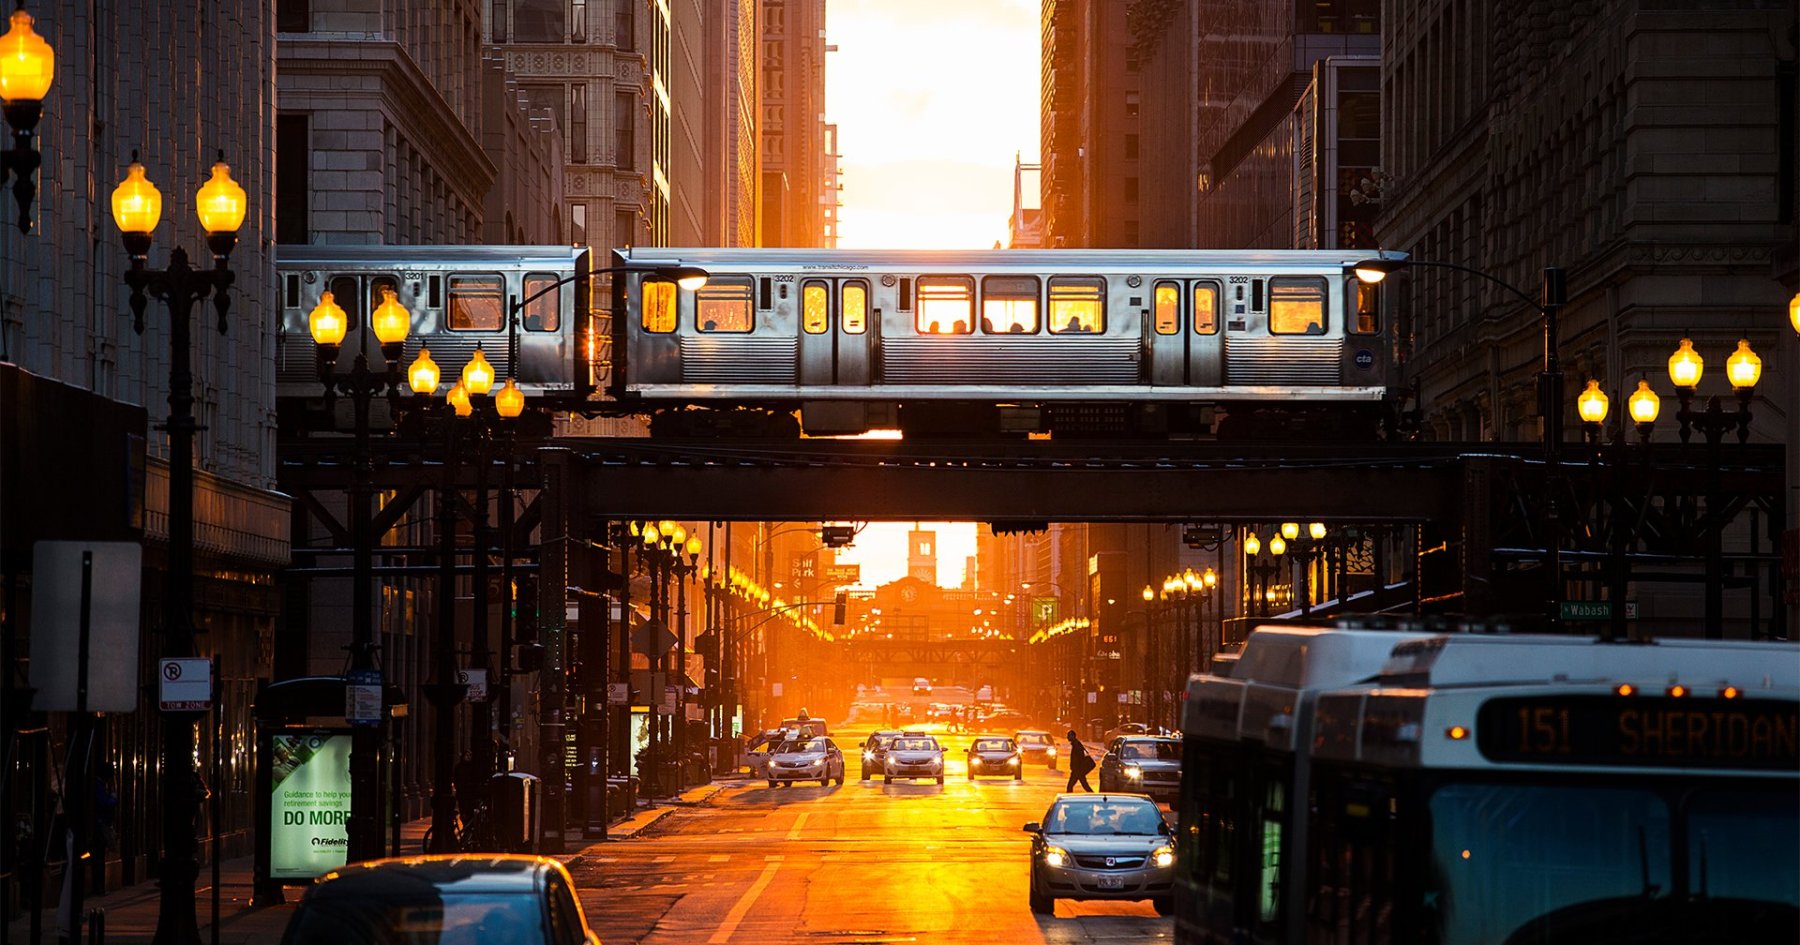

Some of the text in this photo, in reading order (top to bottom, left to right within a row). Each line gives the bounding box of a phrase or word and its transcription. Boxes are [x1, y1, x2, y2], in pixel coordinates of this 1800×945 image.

[405, 272, 424, 280] 3201
[774, 274, 794, 283] 3202
[1229, 275, 1248, 284] 3202
[1355, 354, 1373, 364] cta
[1570, 604, 1609, 616] Wabash
[1517, 705, 1798, 757] 151 SHERIDAN
[323, 791, 338, 800] help
[284, 811, 305, 826] DO
